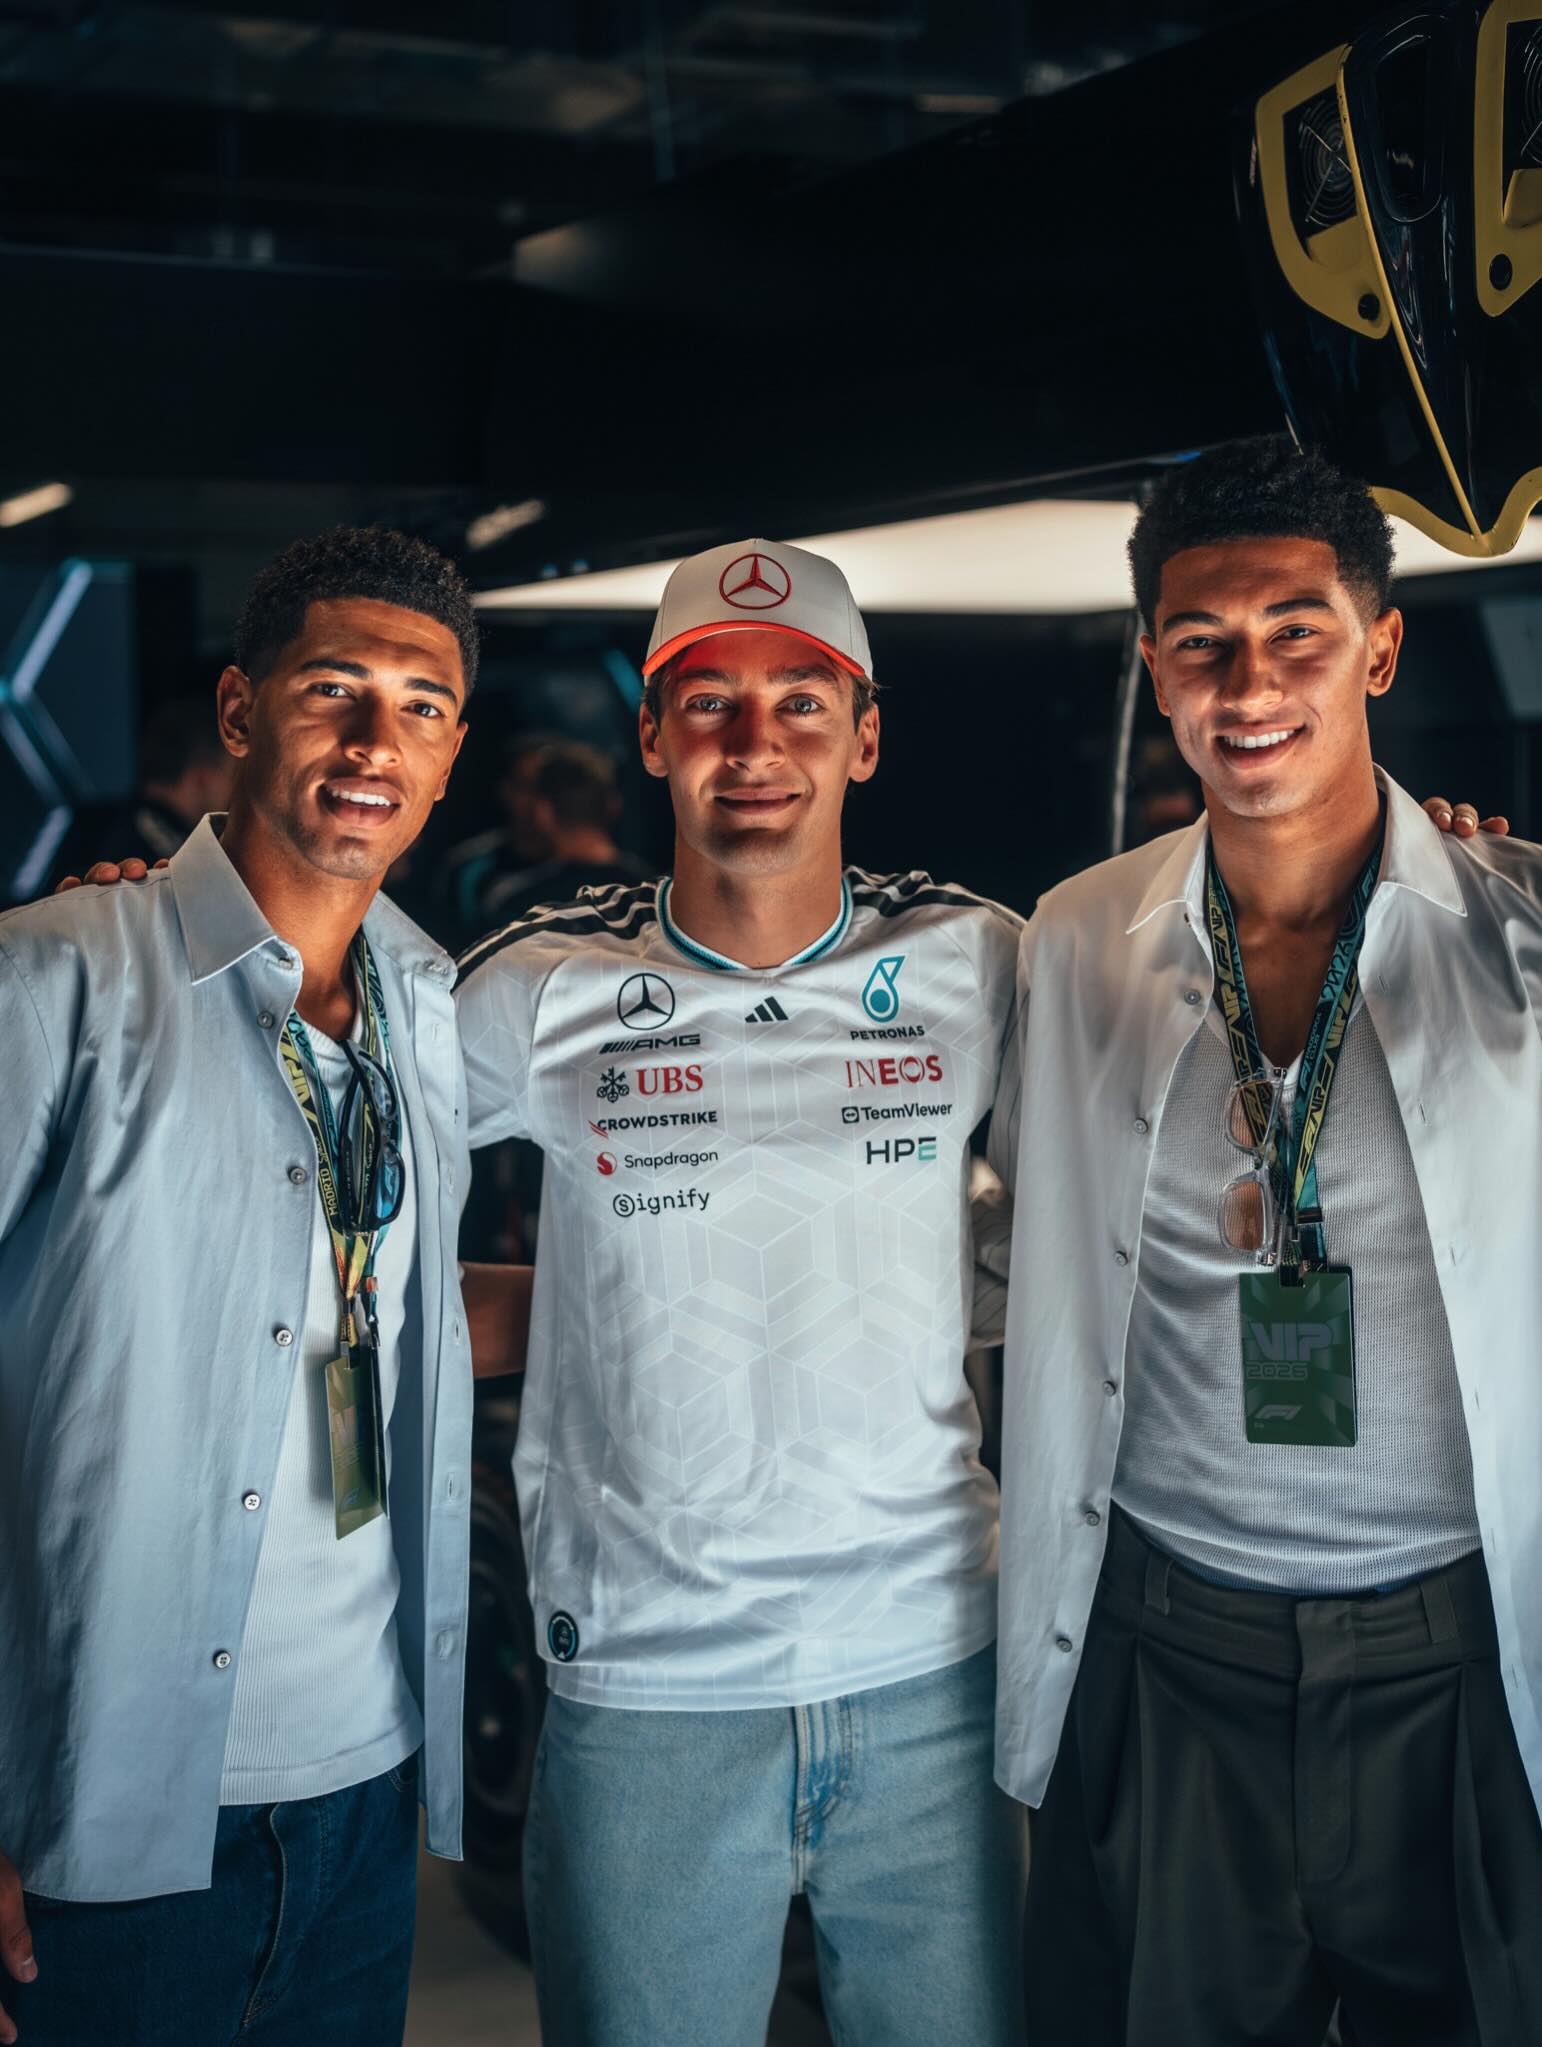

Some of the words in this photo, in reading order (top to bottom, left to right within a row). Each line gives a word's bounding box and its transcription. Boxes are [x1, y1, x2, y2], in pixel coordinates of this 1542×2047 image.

[1221, 983, 1241, 1027] VIP
[632, 1033, 701, 1051] AMG
[850, 1025, 925, 1041] PETRONAS
[635, 1063, 704, 1096] UBS
[845, 1055, 943, 1089] INEOS
[861, 1103, 953, 1121] TeamViewer
[1311, 1086, 1325, 1114] VIP
[597, 1110, 718, 1132] CROWDSTRIKE
[624, 1151, 719, 1170] Snapdragon
[865, 1137, 937, 1165] HPE
[320, 1168, 338, 1216] MADRID
[1251, 1322, 1333, 1361] VIP
[1246, 1362, 1308, 1381] 2026
